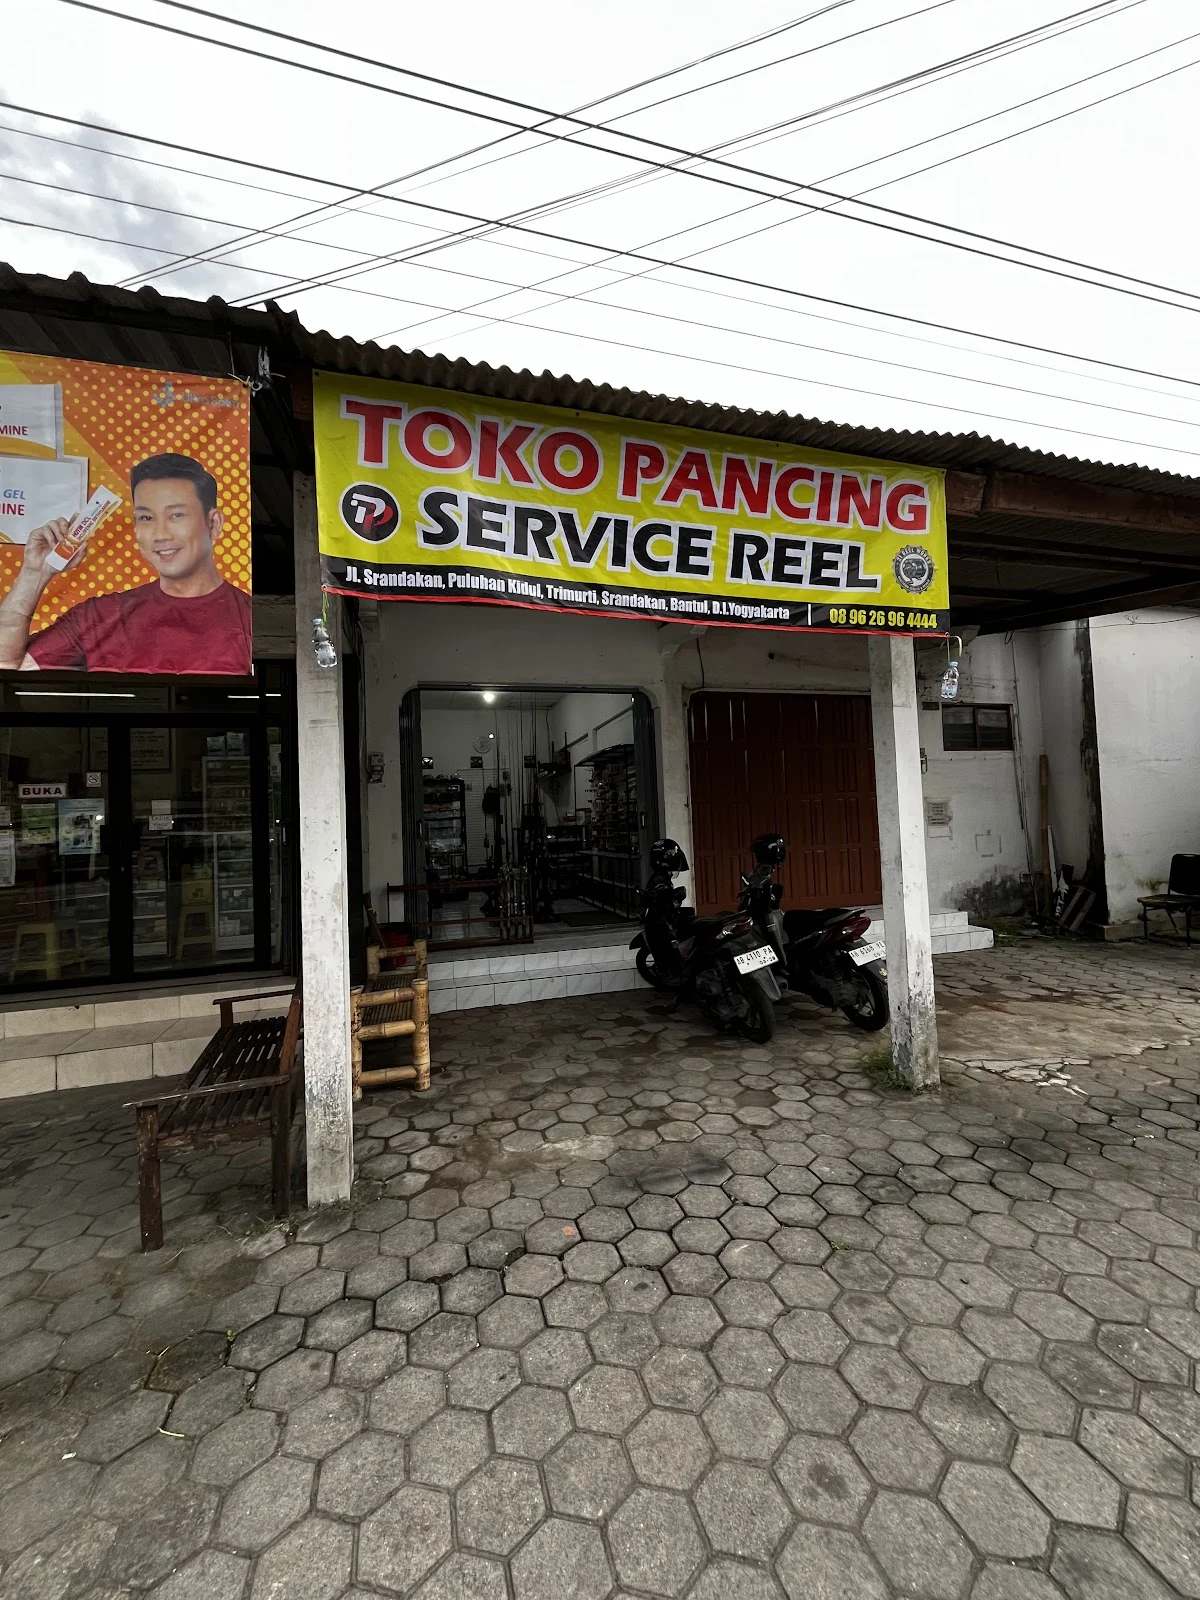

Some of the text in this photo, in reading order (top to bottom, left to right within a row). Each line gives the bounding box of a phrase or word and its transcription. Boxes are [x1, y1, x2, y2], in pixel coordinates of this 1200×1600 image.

[346, 399, 928, 531] TOKO PANCING
[3, 489, 25, 500] GEL
[422, 492, 878, 588] SERVICE REEL
[346, 566, 790, 620] Jl. Srandakan, Puluhan Kidul, Trimurti, Srandakan, Bantul, D.I.Yogyakarta
[830, 608, 937, 628] 08 96 26 96 4444
